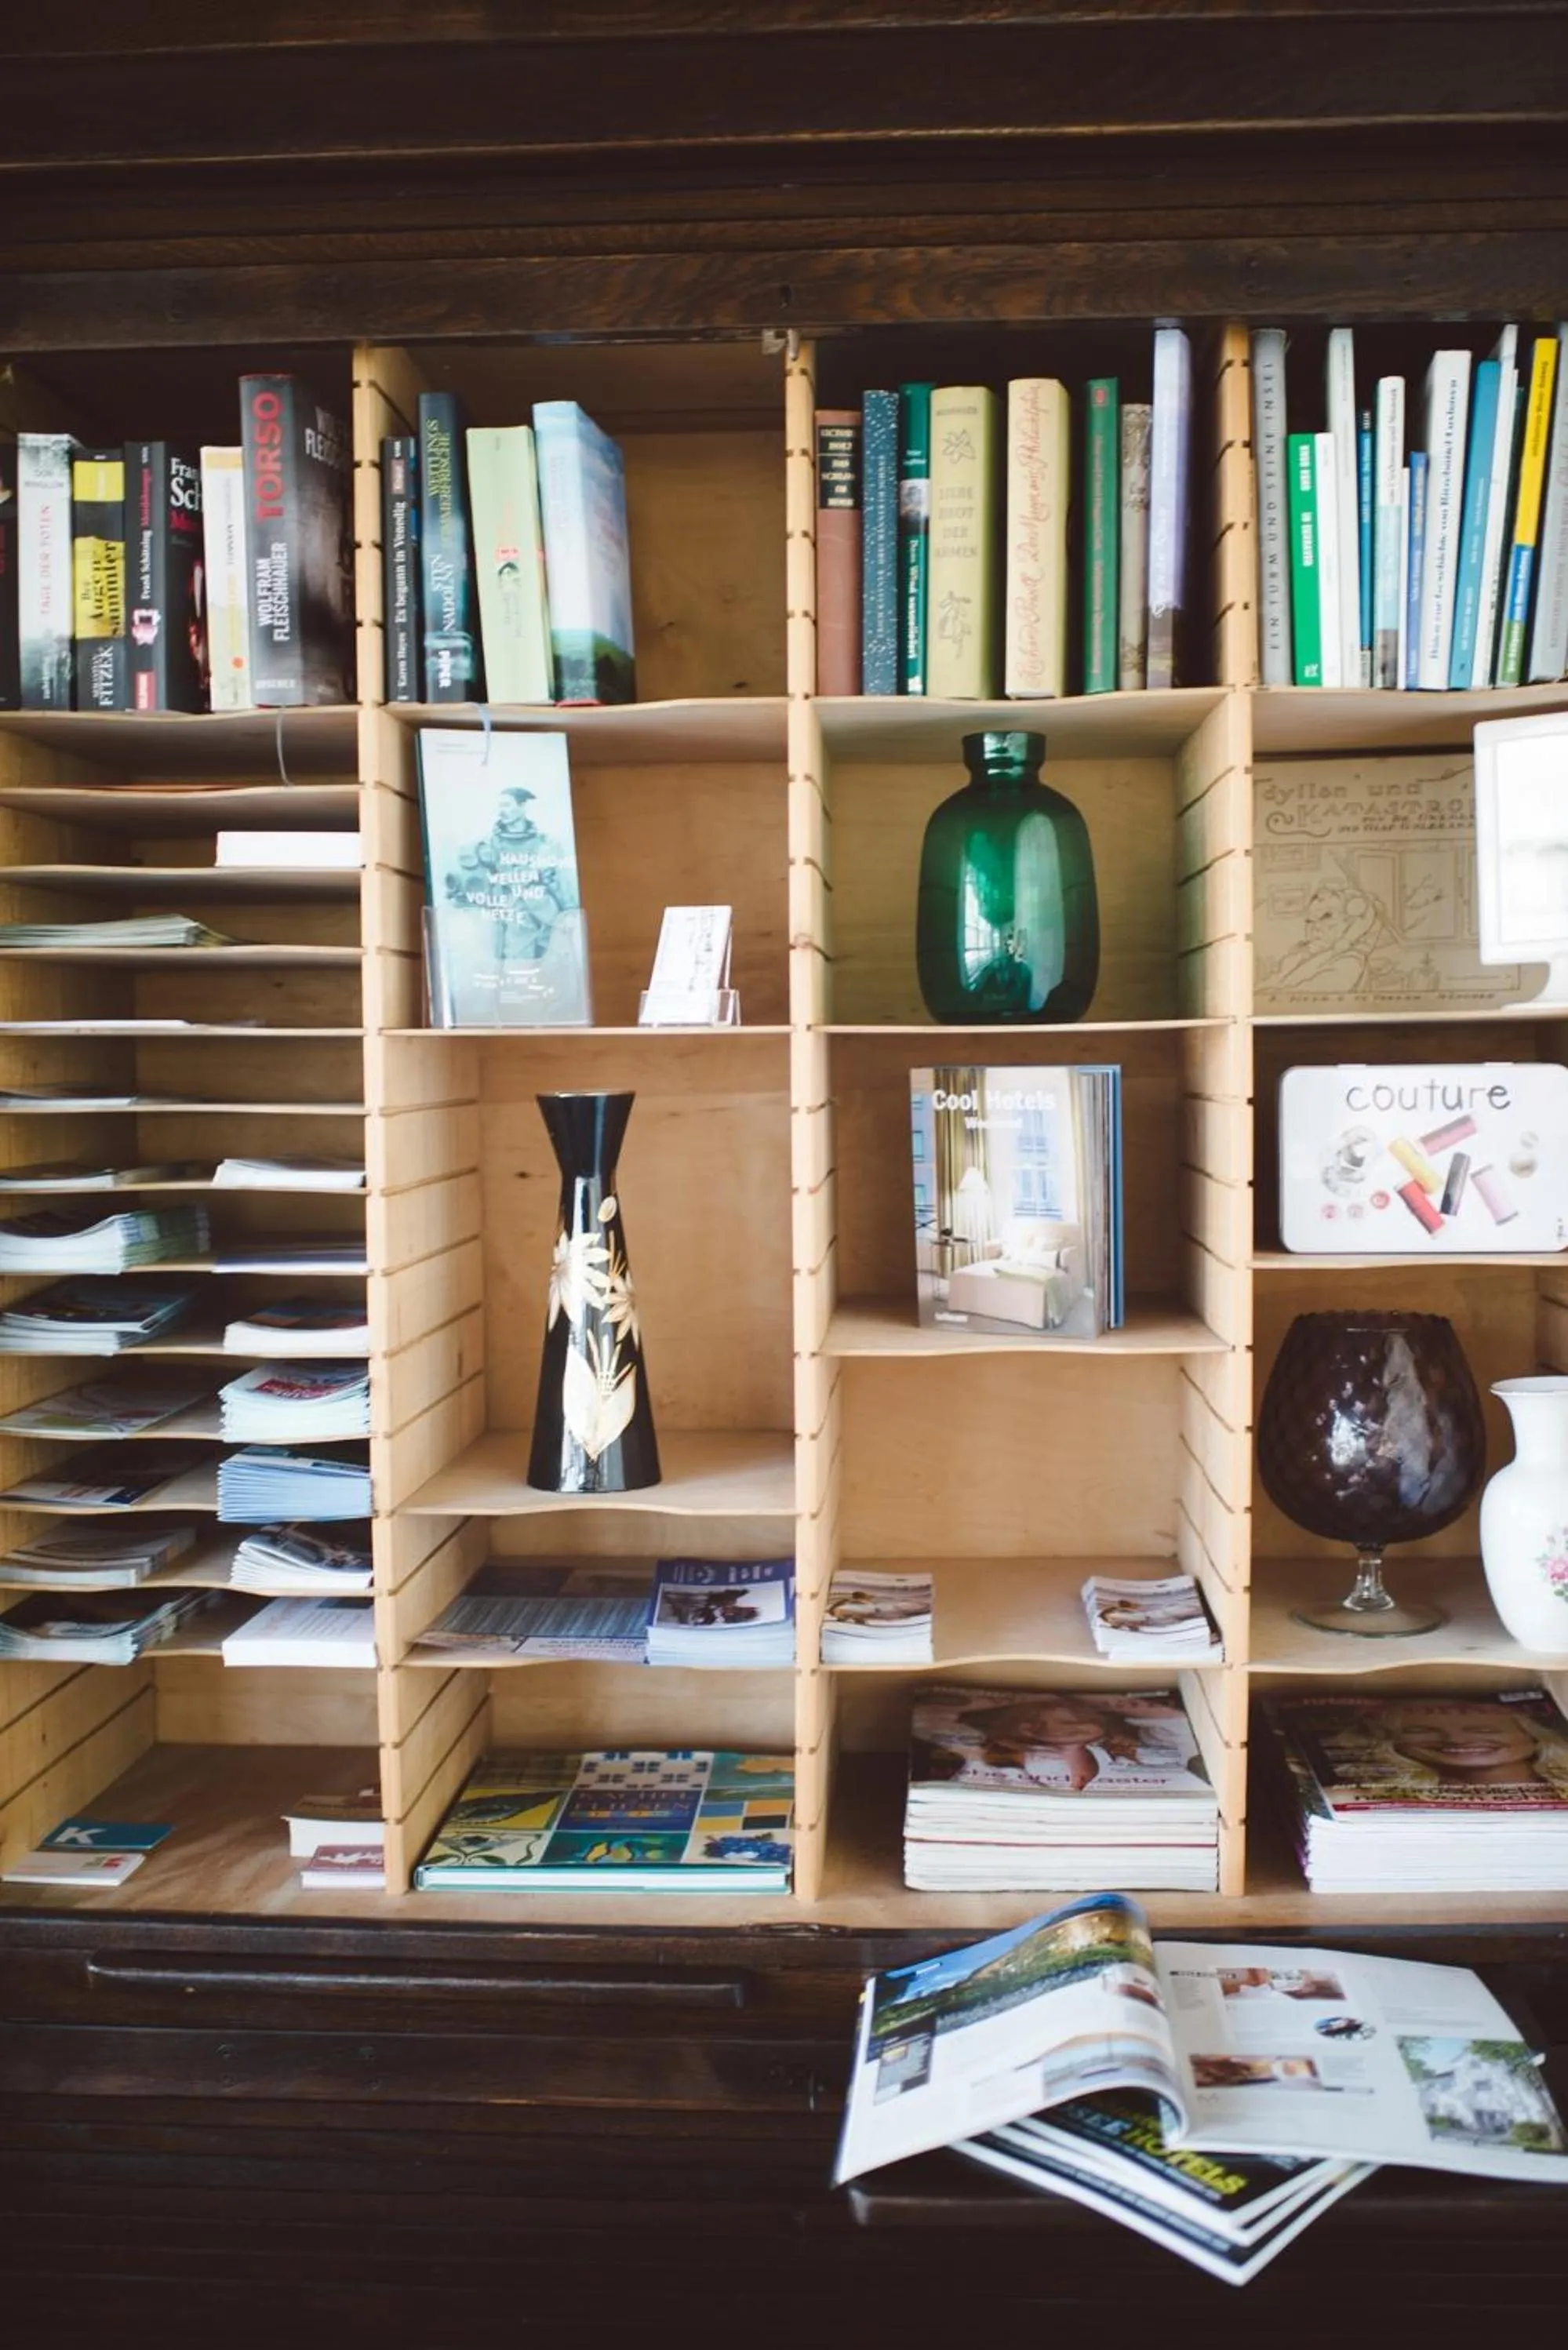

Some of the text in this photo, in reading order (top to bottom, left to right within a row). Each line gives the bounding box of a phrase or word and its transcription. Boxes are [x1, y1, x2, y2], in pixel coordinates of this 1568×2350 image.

[253, 391, 286, 524] TORSO
[1262, 362, 1279, 651] EIN TURM UND SEINE INSEL
[392, 500, 406, 548] Venedig
[40, 504, 52, 615] TAGE DER TOTEN
[393, 549, 405, 562] in
[103, 542, 122, 636] sammler
[140, 573, 152, 600] Frank
[256, 558, 272, 628] WOLFRAM
[271, 542, 290, 642] FLEISCHHAUER
[394, 563, 408, 607] begann
[394, 607, 407, 624] Es
[97, 644, 115, 706] FITZEK
[1297, 797, 1475, 828] KATASTRO
[486, 868, 540, 885] WELLEN
[511, 884, 547, 900] UND
[465, 890, 510, 908] VOLLE
[931, 1088, 1057, 1111] Cool Hotels
[1345, 1079, 1512, 1112] couture
[1017, 1772, 1071, 1784] und
[53, 1826, 109, 1845] K
